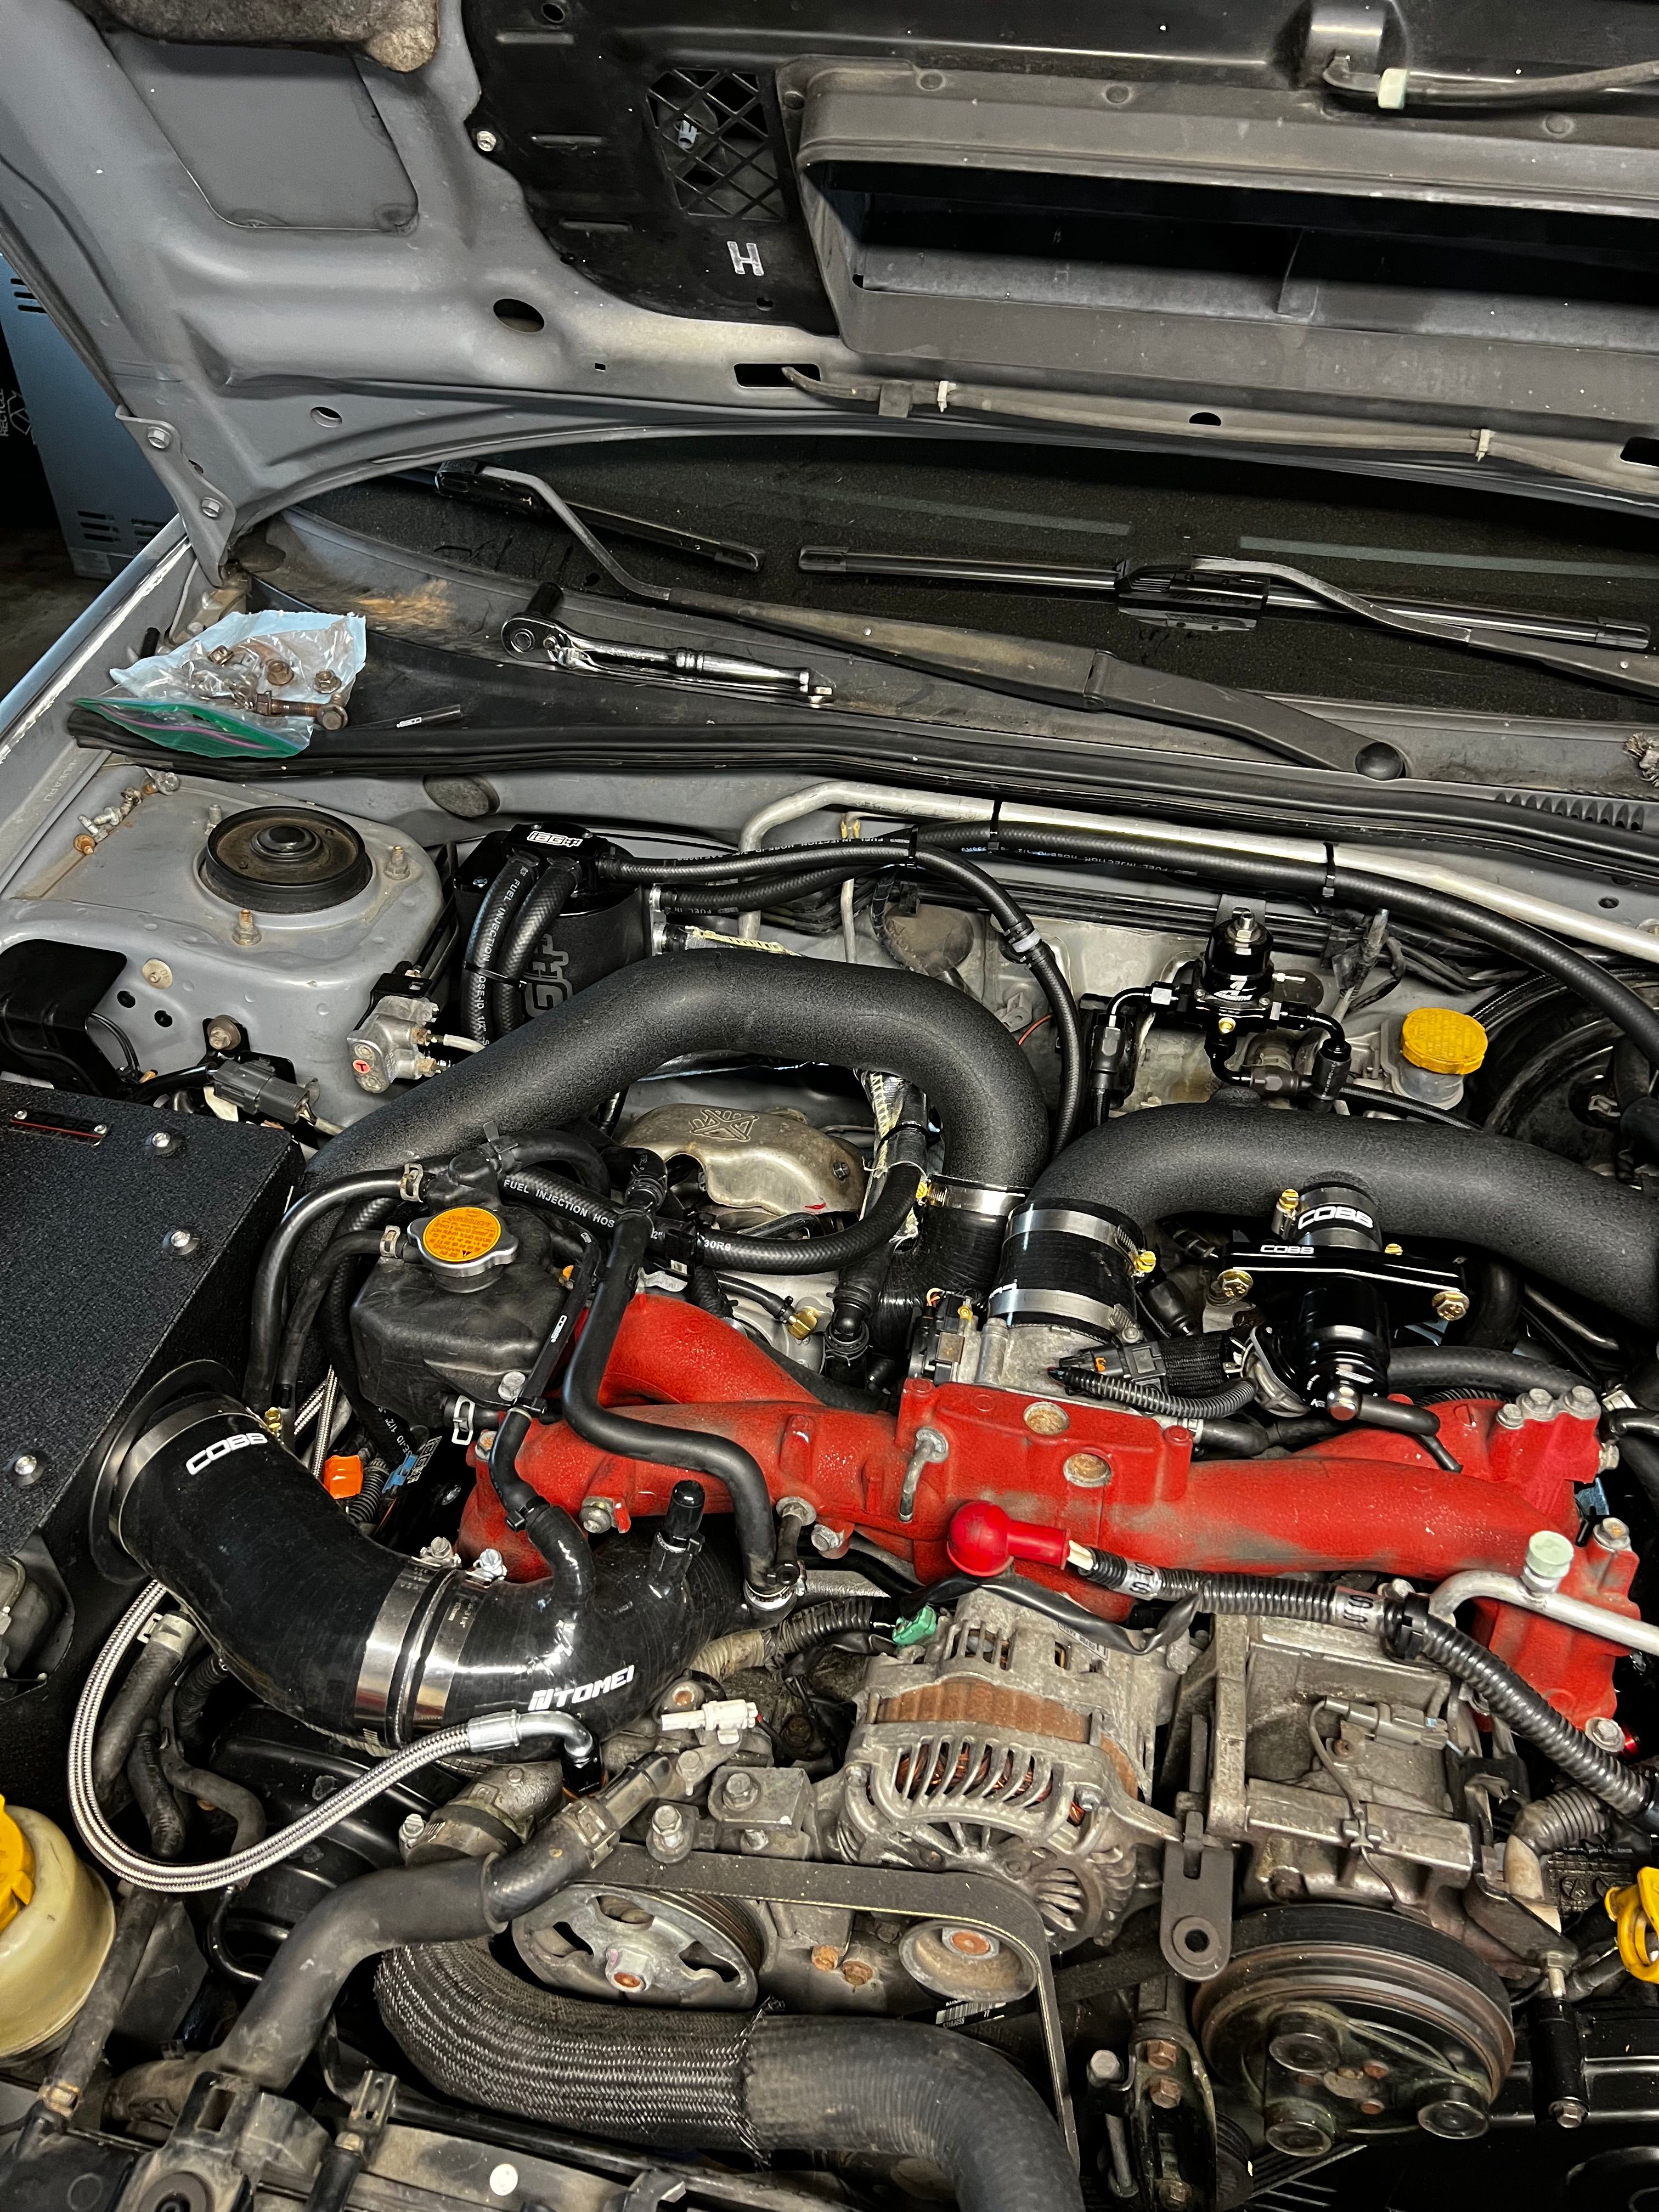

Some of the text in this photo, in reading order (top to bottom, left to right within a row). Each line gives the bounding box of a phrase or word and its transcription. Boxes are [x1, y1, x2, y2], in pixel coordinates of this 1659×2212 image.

[503, 878, 521, 901] FUEL
[482, 907, 506, 962] INJECTION
[356, 1063, 366, 1072] T
[503, 1179, 529, 1194] FUEL
[535, 1189, 588, 1217] INJECTION
[1297, 1206, 1374, 1230] COBB
[1260, 1245, 1314, 1255] COBB
[185, 1432, 268, 1475] COBB
[553, 1664, 635, 1707] TOMEI
